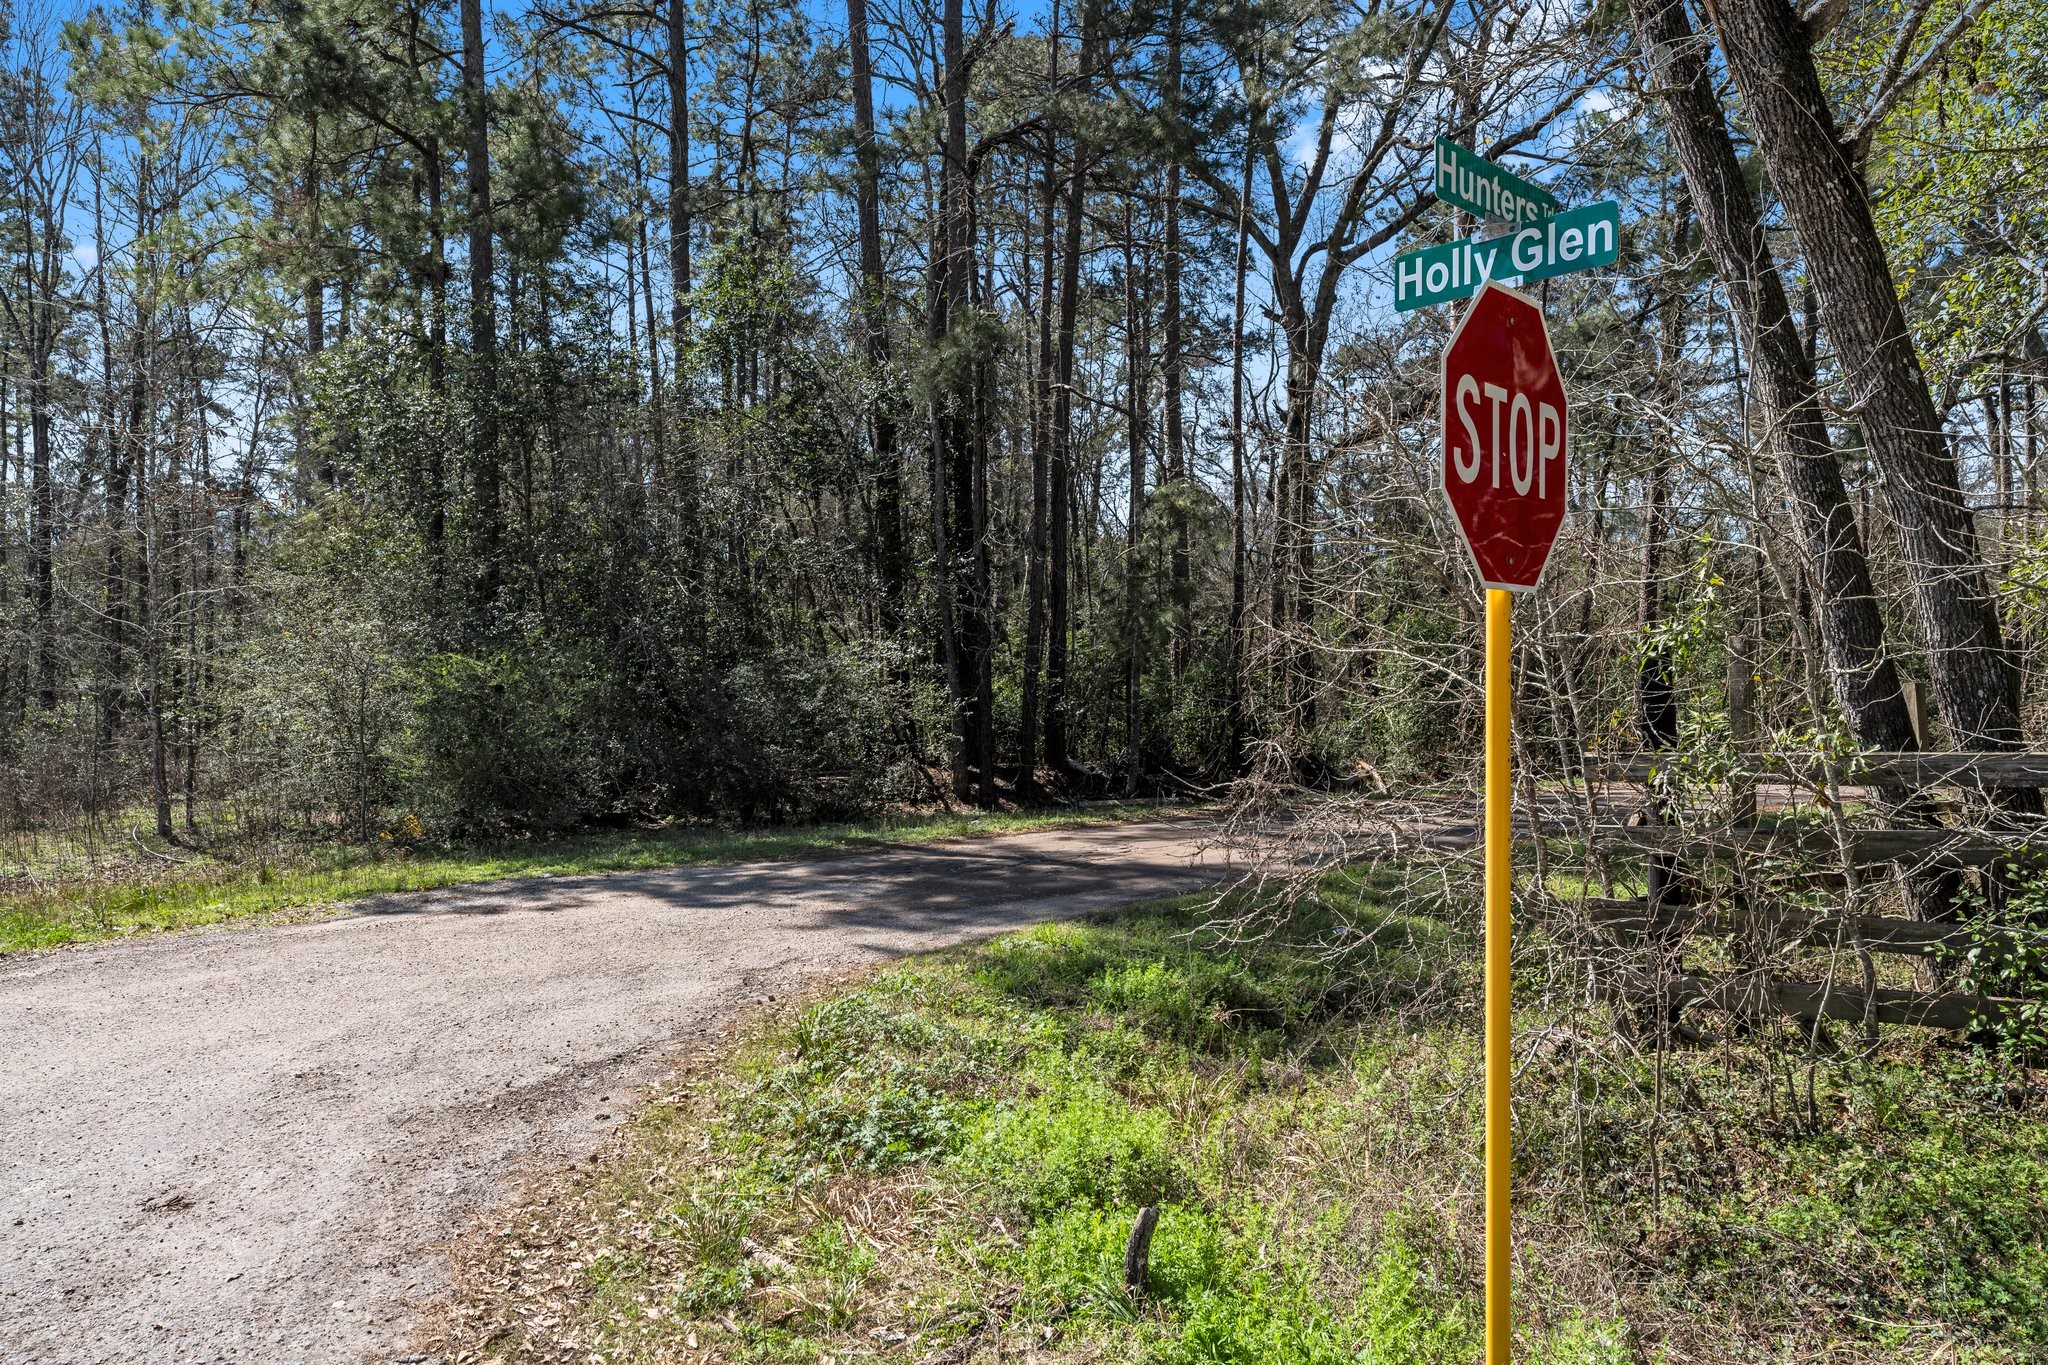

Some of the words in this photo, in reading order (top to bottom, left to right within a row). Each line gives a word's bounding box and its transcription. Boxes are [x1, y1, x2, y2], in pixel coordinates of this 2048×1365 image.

[1438, 144, 1539, 223] Hunters
[1398, 244, 1498, 301] Holly
[1511, 219, 1613, 272] Glen
[1453, 373, 1561, 500] STOP
